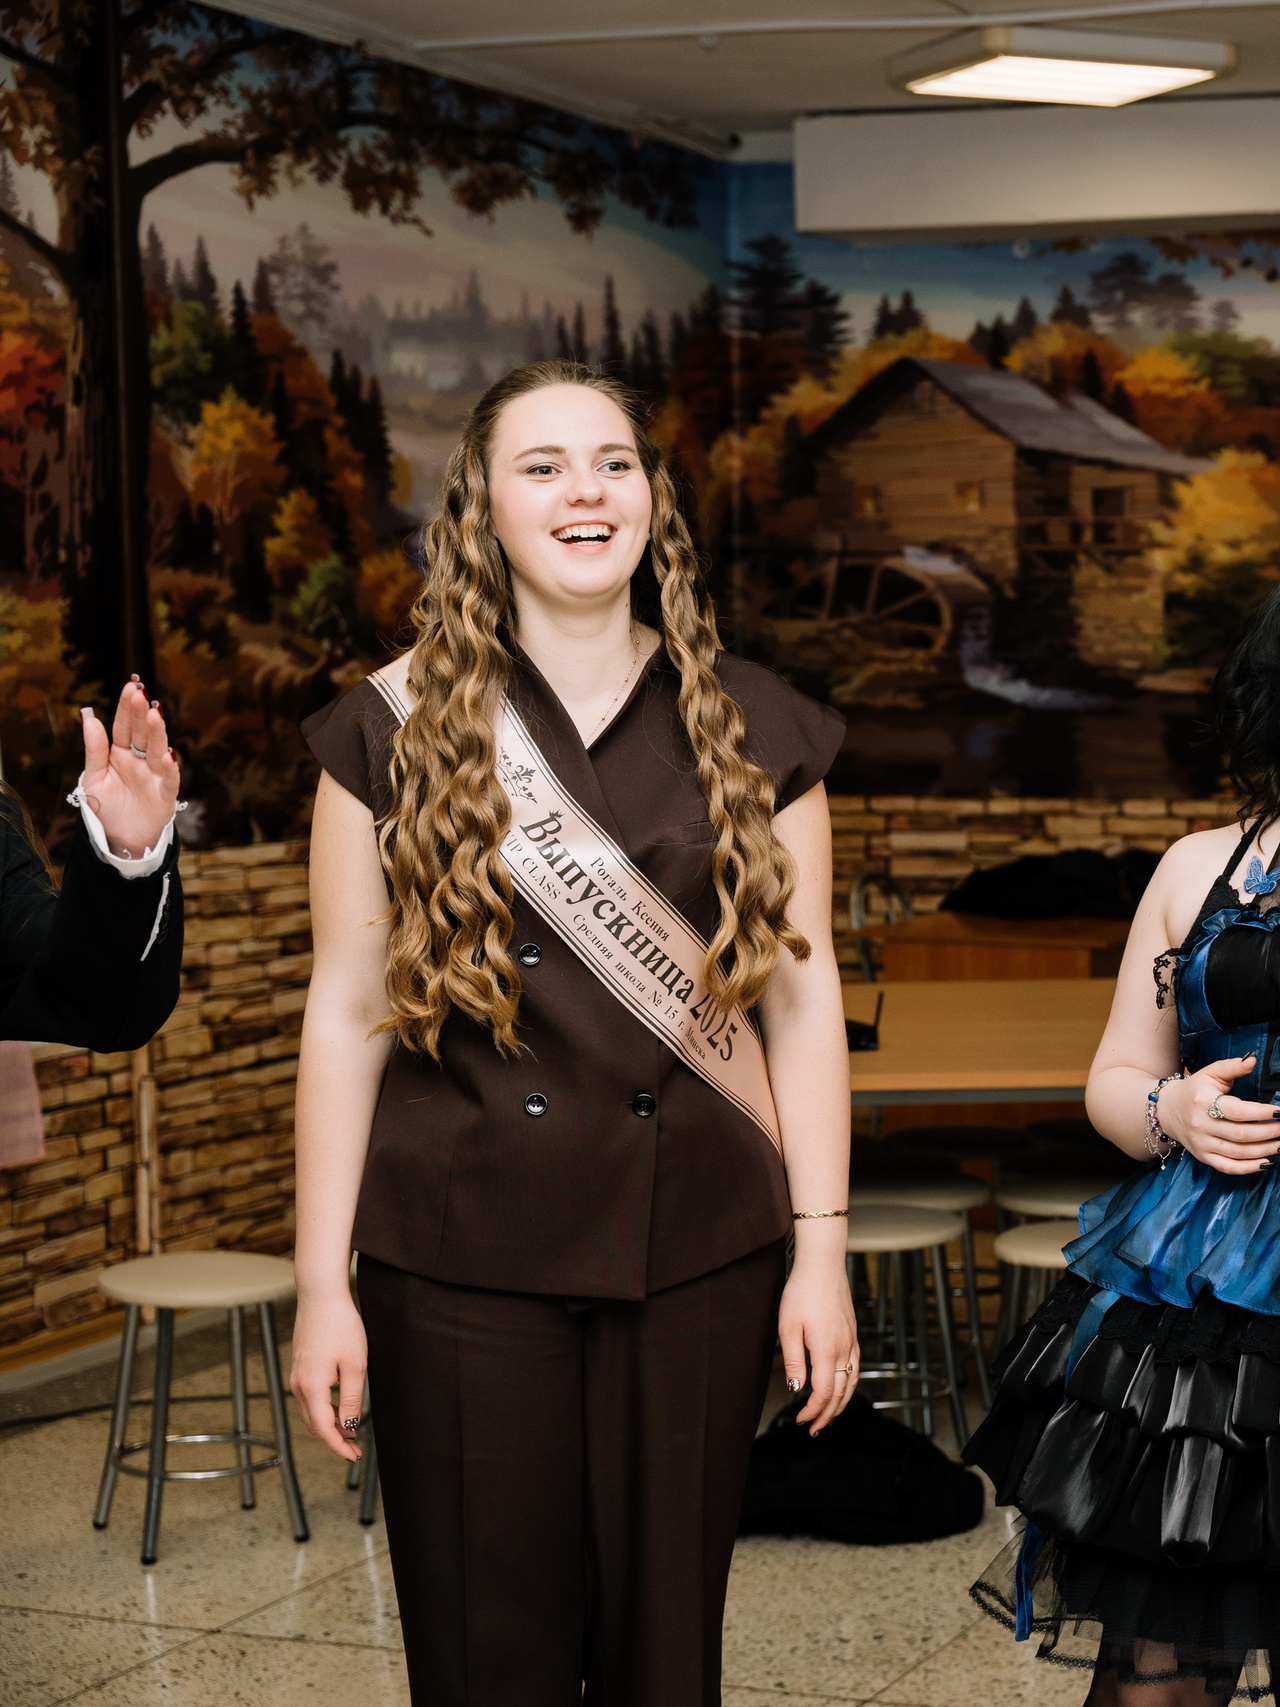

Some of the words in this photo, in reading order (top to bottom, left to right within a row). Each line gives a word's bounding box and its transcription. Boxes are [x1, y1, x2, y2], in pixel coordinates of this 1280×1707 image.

[504, 829, 523, 854] VIP
[521, 857, 562, 900] CLASS
[519, 815, 695, 1004] Выпускница
[590, 856, 628, 902] Рогаль
[631, 900, 670, 942] Ксения
[573, 913, 614, 961] Средняя
[615, 962, 647, 993] школа
[647, 990, 663, 1007] №
[664, 1005, 679, 1020] 15
[677, 1020, 686, 1031] г.
[685, 1026, 707, 1060] Минска
